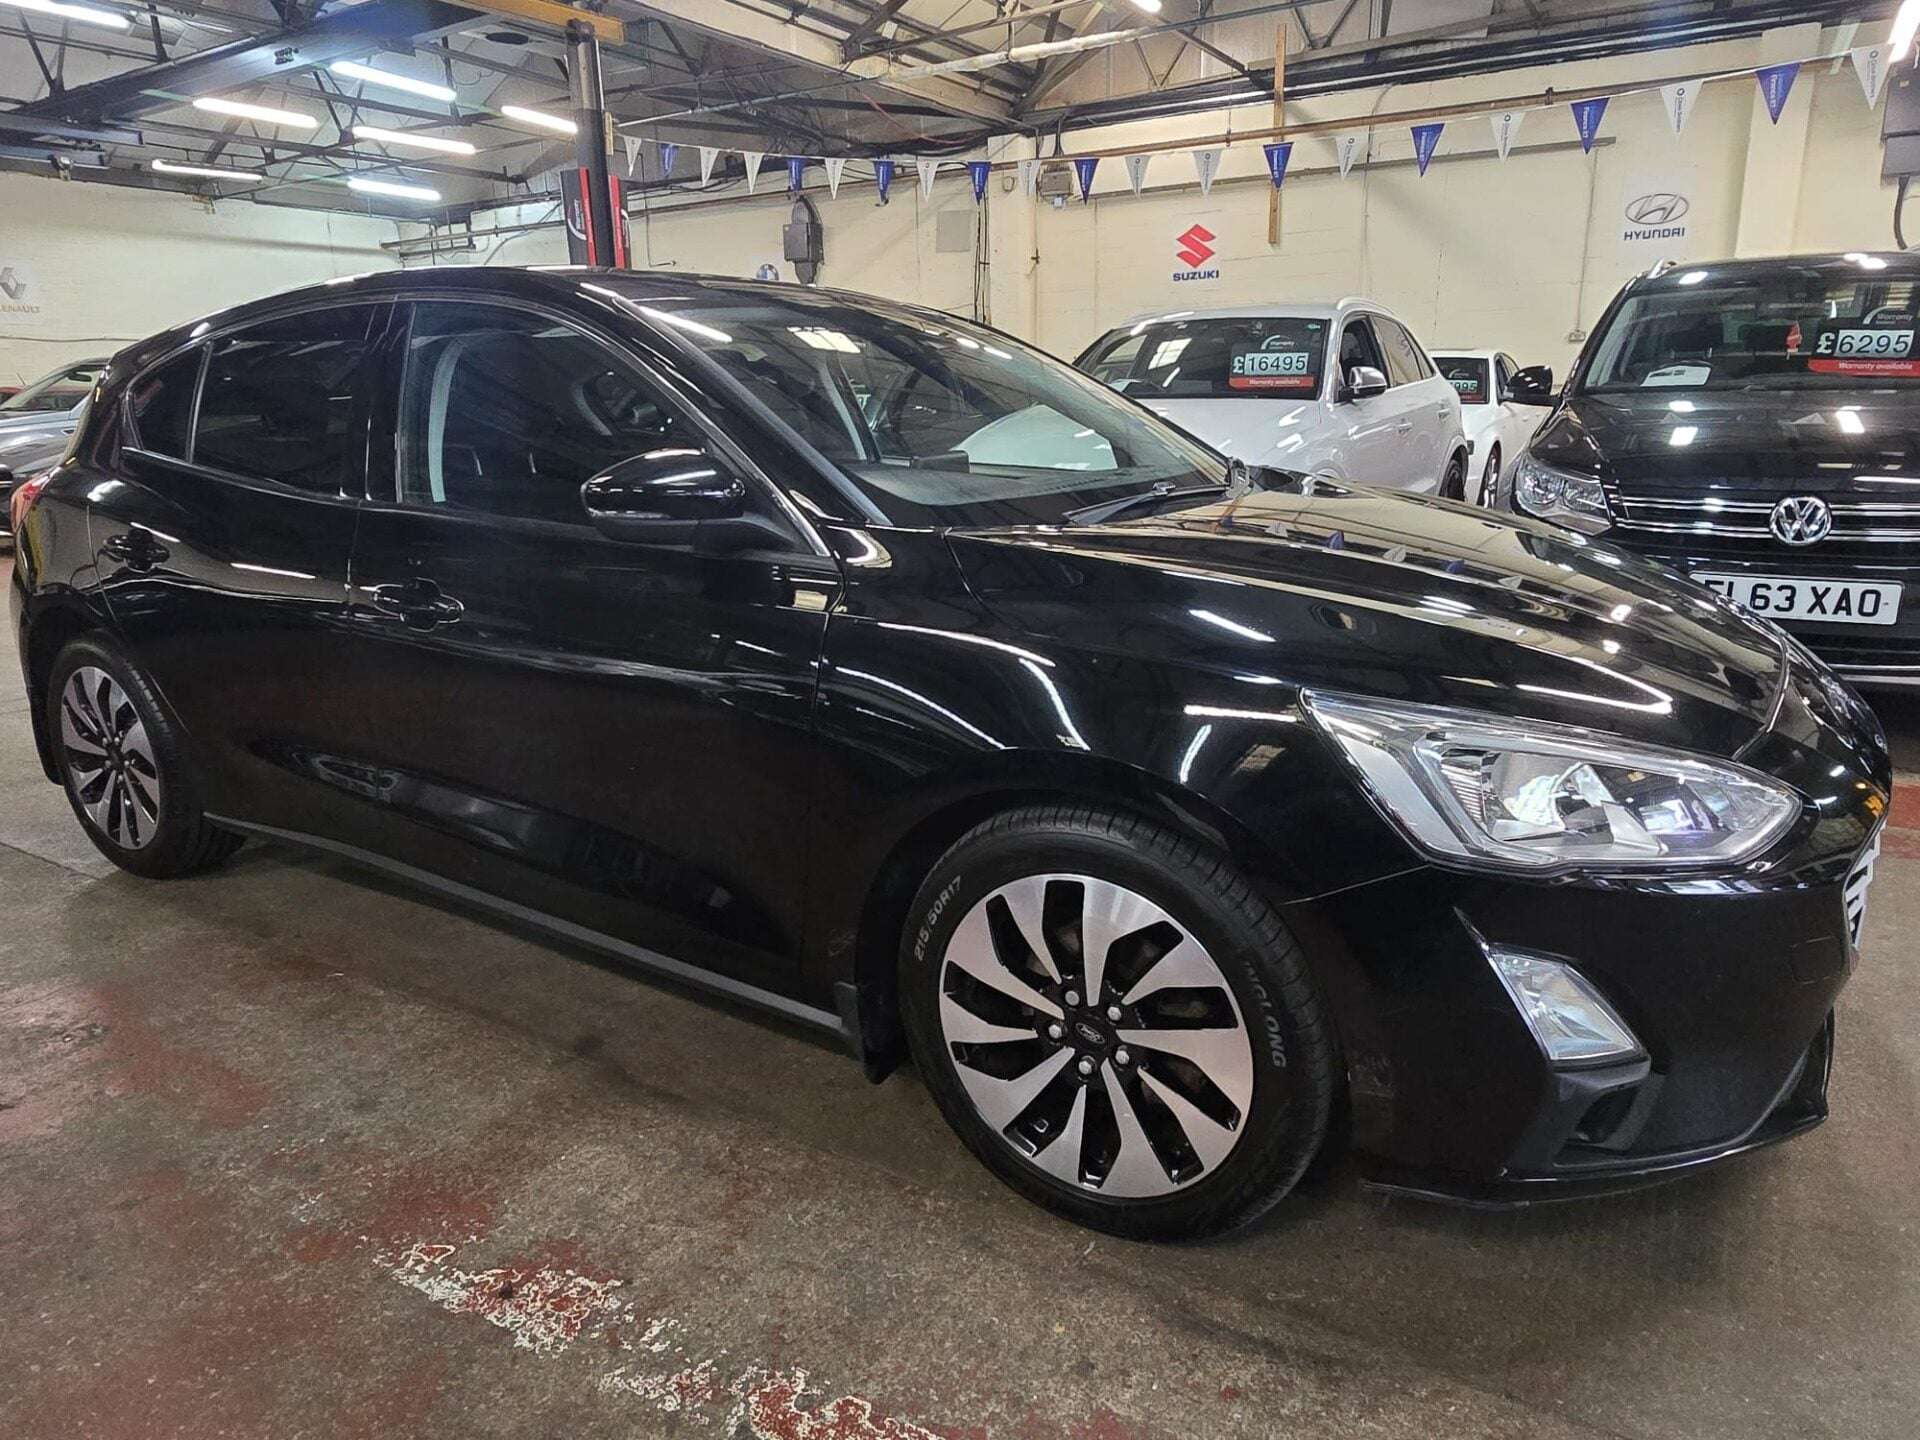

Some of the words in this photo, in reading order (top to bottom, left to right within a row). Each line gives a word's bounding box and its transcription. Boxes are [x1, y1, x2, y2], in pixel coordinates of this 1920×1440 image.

[1624, 227, 1686, 241] HYUNDAI
[1173, 269, 1220, 281] SUZUKI
[0, 303, 41, 314] ENAULT
[1806, 586, 1882, 617] XAO
